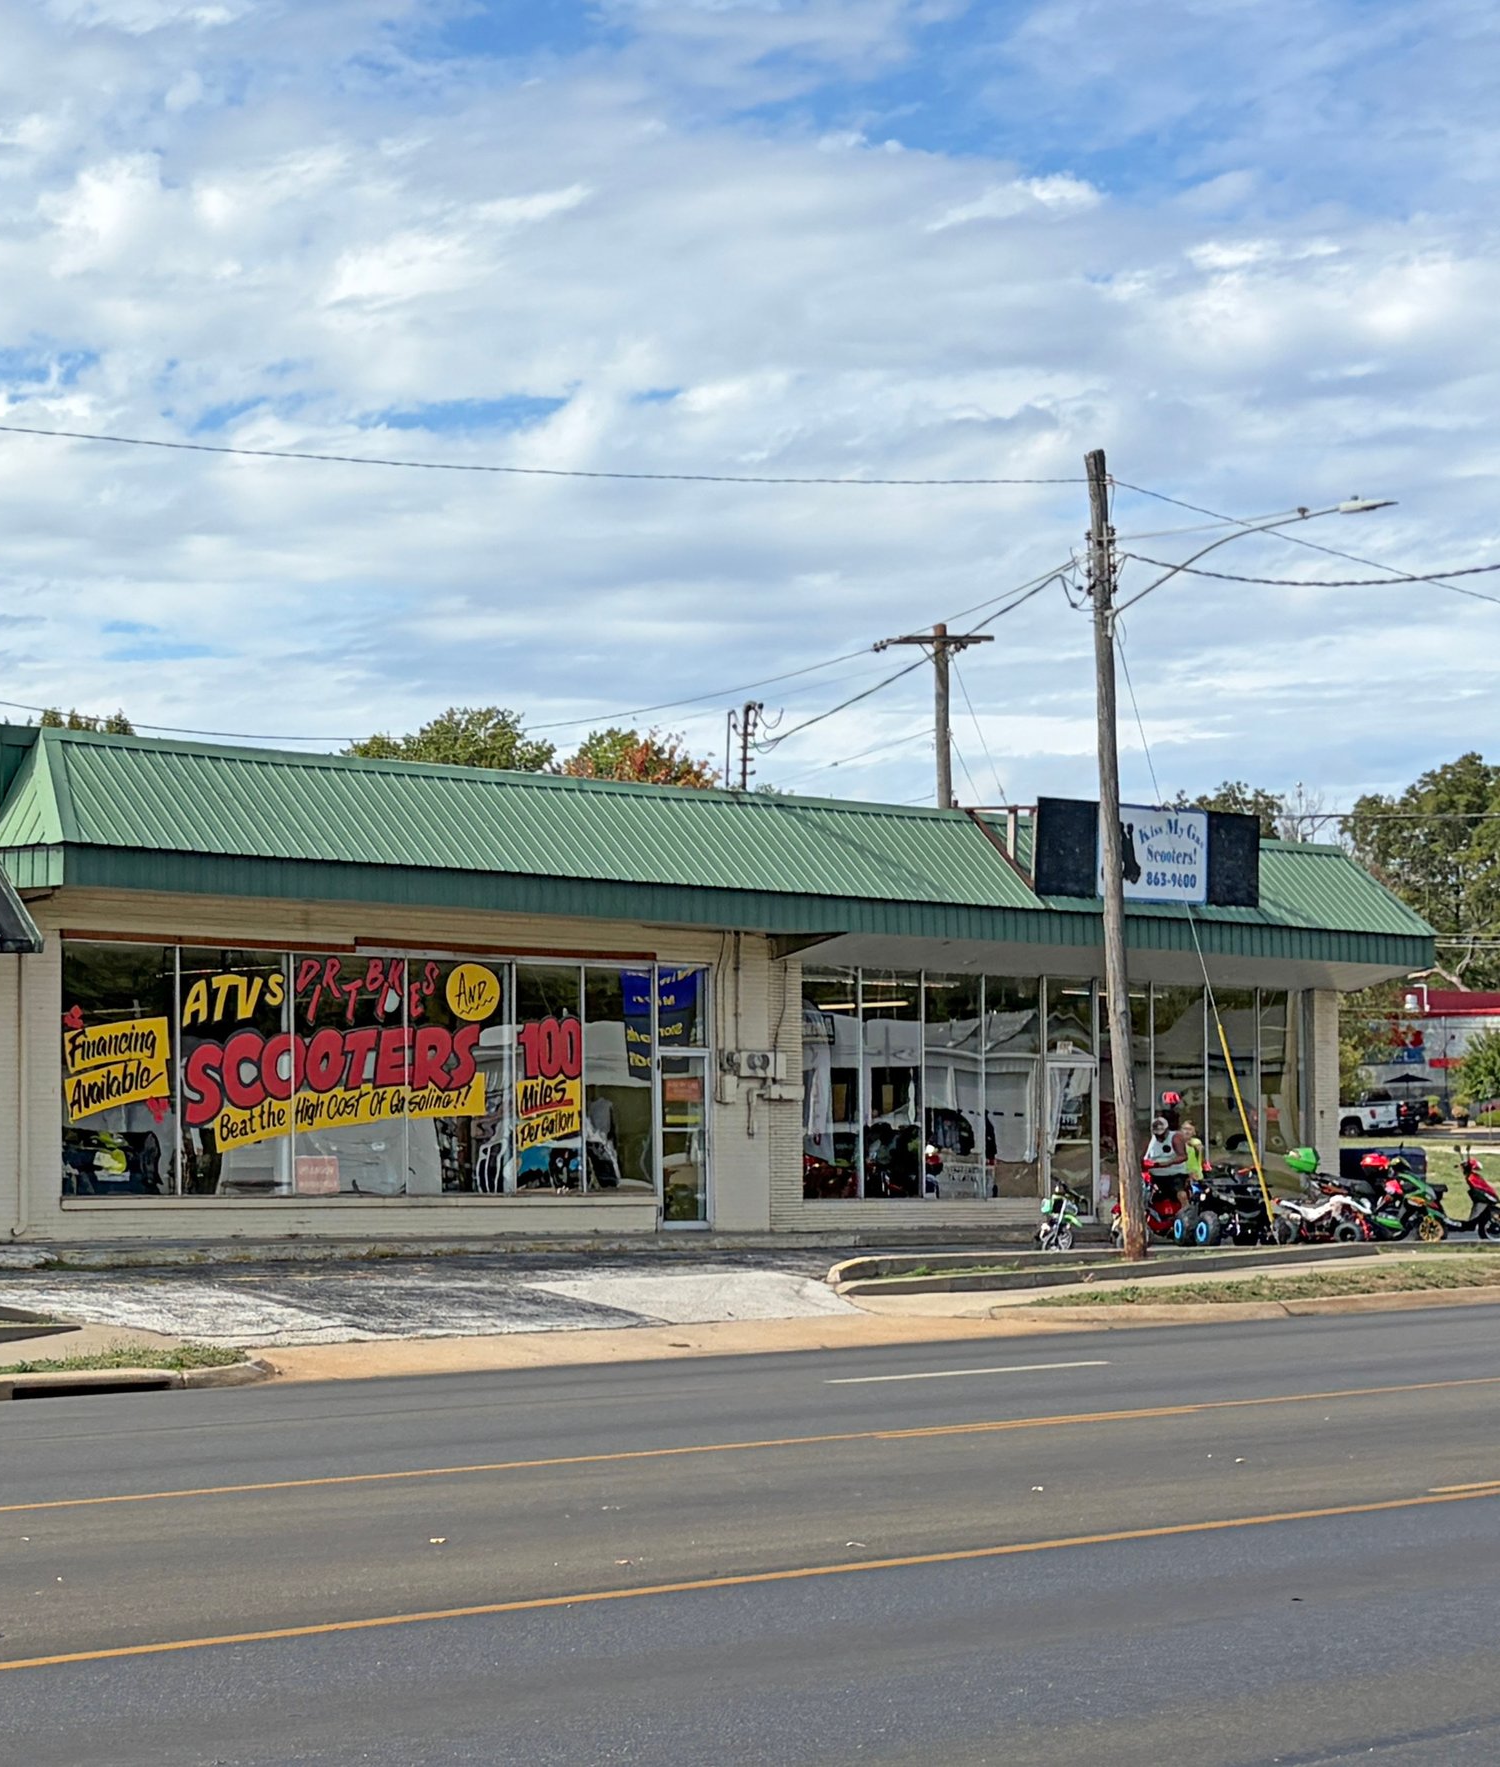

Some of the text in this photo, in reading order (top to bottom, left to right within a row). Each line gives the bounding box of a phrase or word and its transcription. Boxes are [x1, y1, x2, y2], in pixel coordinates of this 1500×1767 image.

[1166, 818, 1183, 838] My
[1146, 844, 1197, 866] Scooters!
[296, 957, 364, 1026] DIRT
[68, 1024, 156, 1068] Financing
[517, 1016, 582, 1080] 100
[70, 1060, 164, 1118] Available
[184, 1023, 480, 1126] SCOOTERS
[521, 1079, 567, 1114] Miles
[220, 1108, 256, 1141] Beat
[259, 1100, 286, 1130] the
[295, 1094, 324, 1126] High
[520, 1111, 575, 1147] Per Gallon
